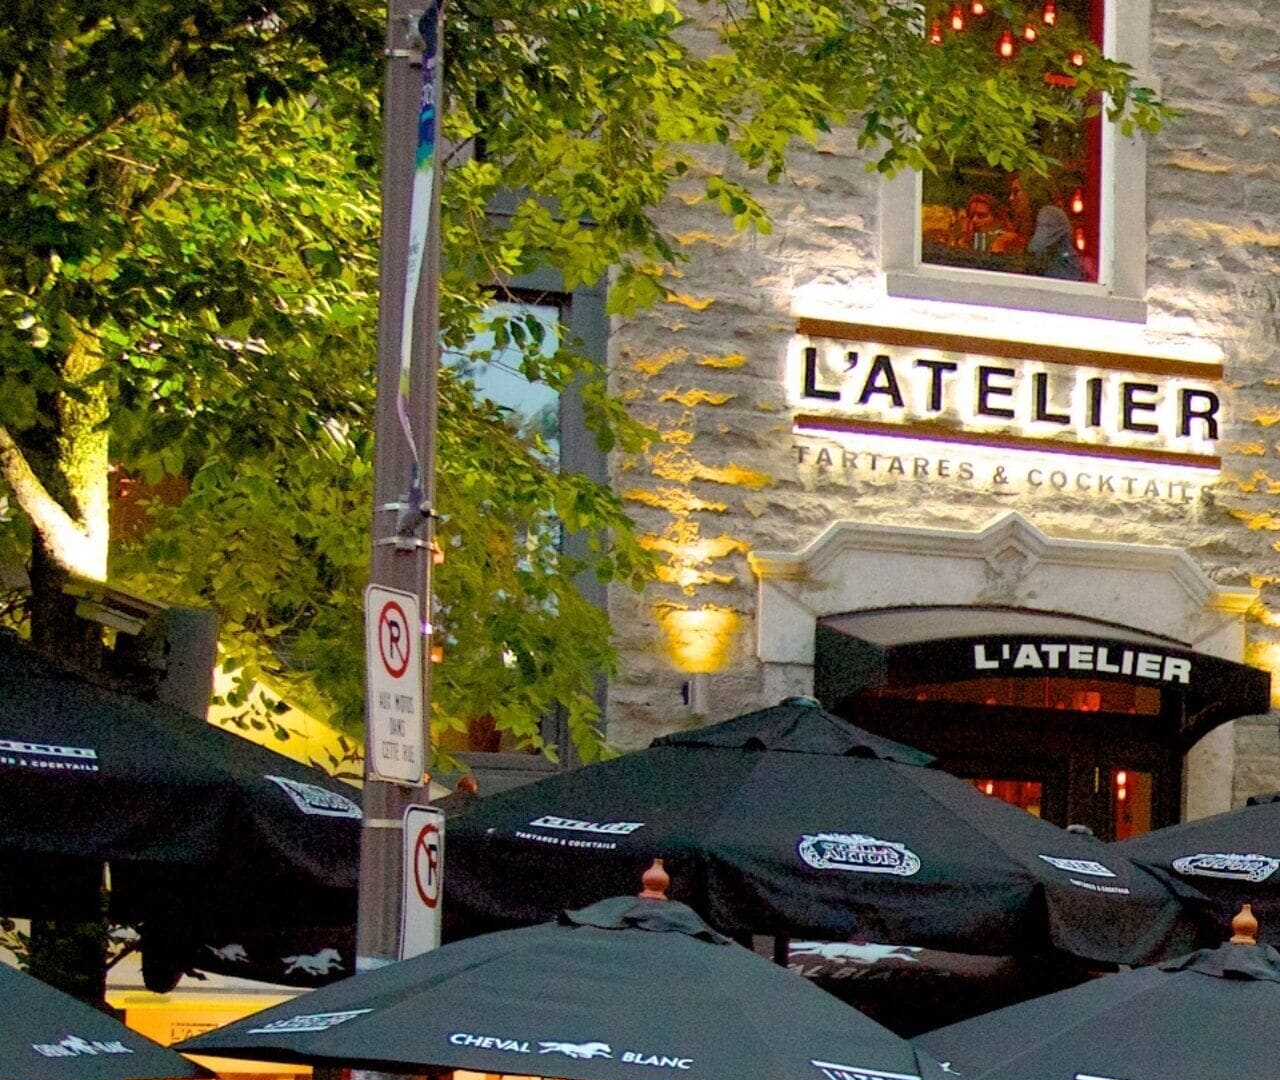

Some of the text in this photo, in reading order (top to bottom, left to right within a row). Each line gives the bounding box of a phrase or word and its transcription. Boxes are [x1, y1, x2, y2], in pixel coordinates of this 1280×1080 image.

[801, 346, 1221, 440] L'ATELIER
[792, 443, 1216, 502] TARTARES & COCKTAILS
[973, 643, 1193, 684] L'ATELIER
[450, 1033, 694, 1070] CHEVAL BLANC
